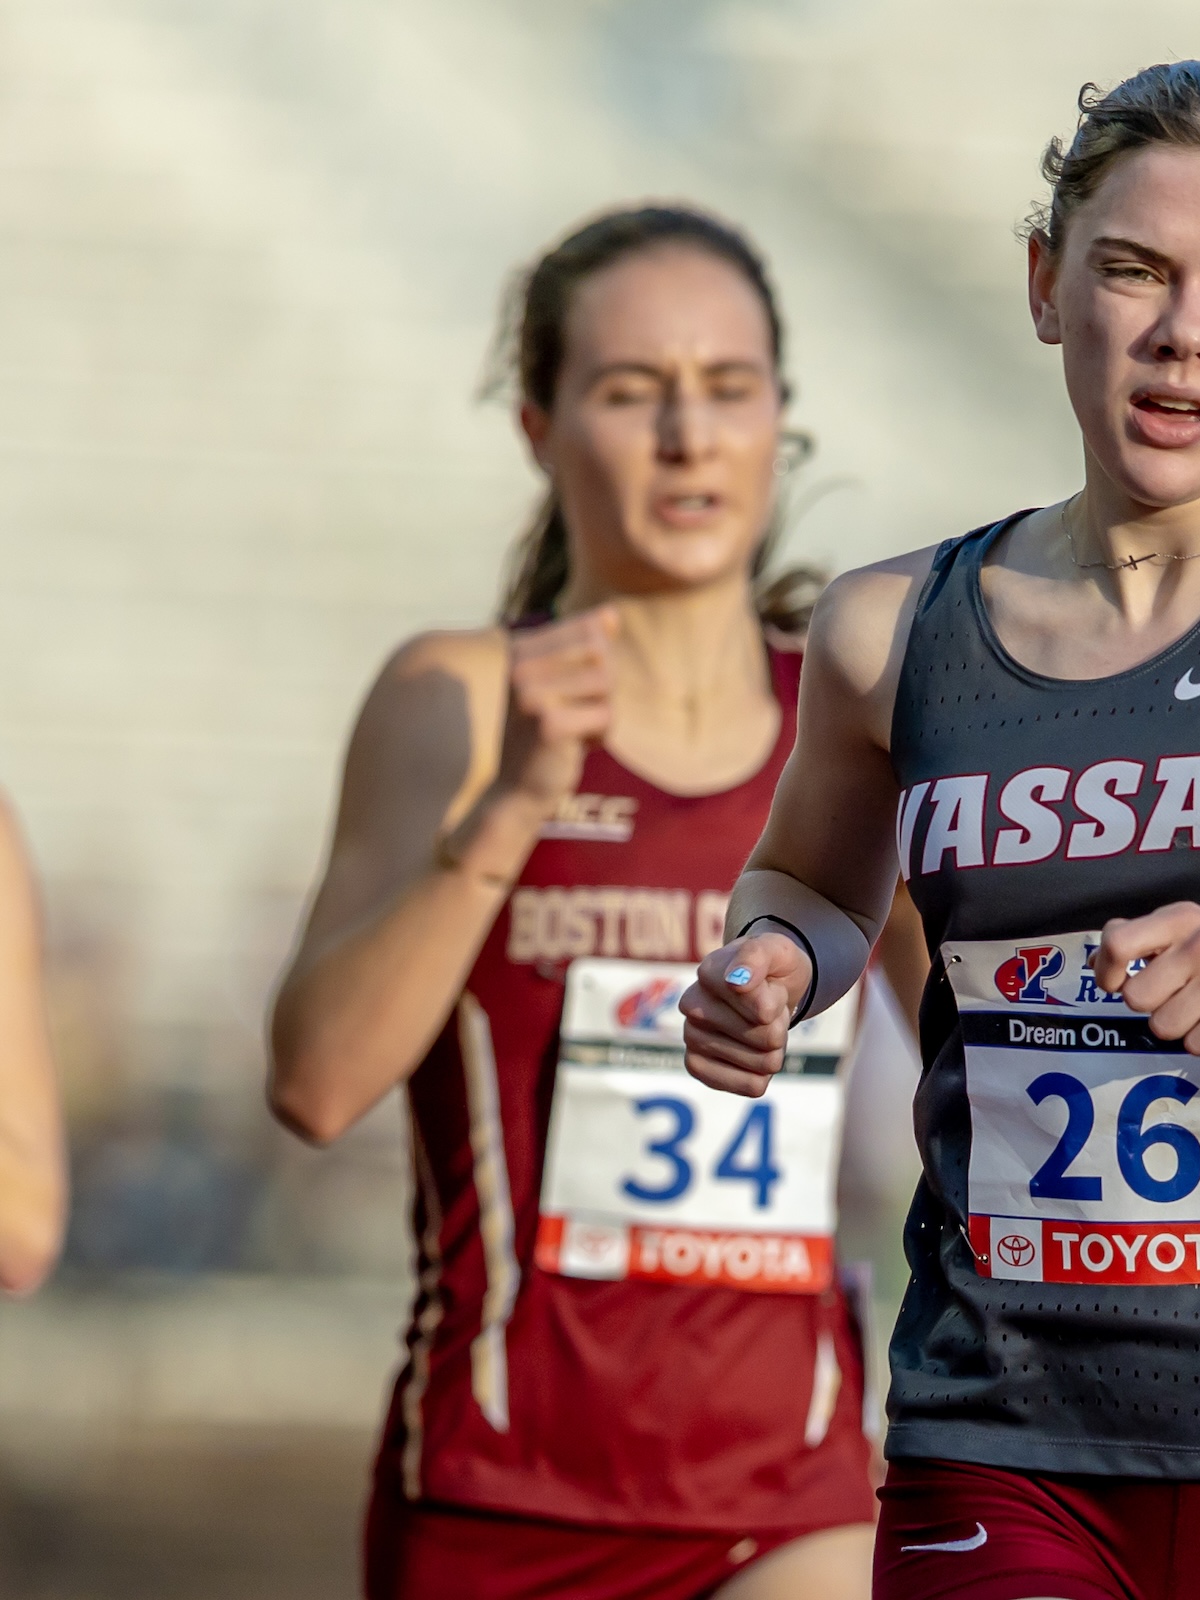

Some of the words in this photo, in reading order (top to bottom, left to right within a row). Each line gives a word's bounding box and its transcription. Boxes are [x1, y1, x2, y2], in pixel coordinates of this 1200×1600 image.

[506, 885, 692, 963] BOSTON
[1008, 1018, 1076, 1046] Dream
[1081, 1022, 1127, 1047] On.
[619, 1091, 784, 1213] 34
[638, 1228, 815, 1283] TOYOTA
